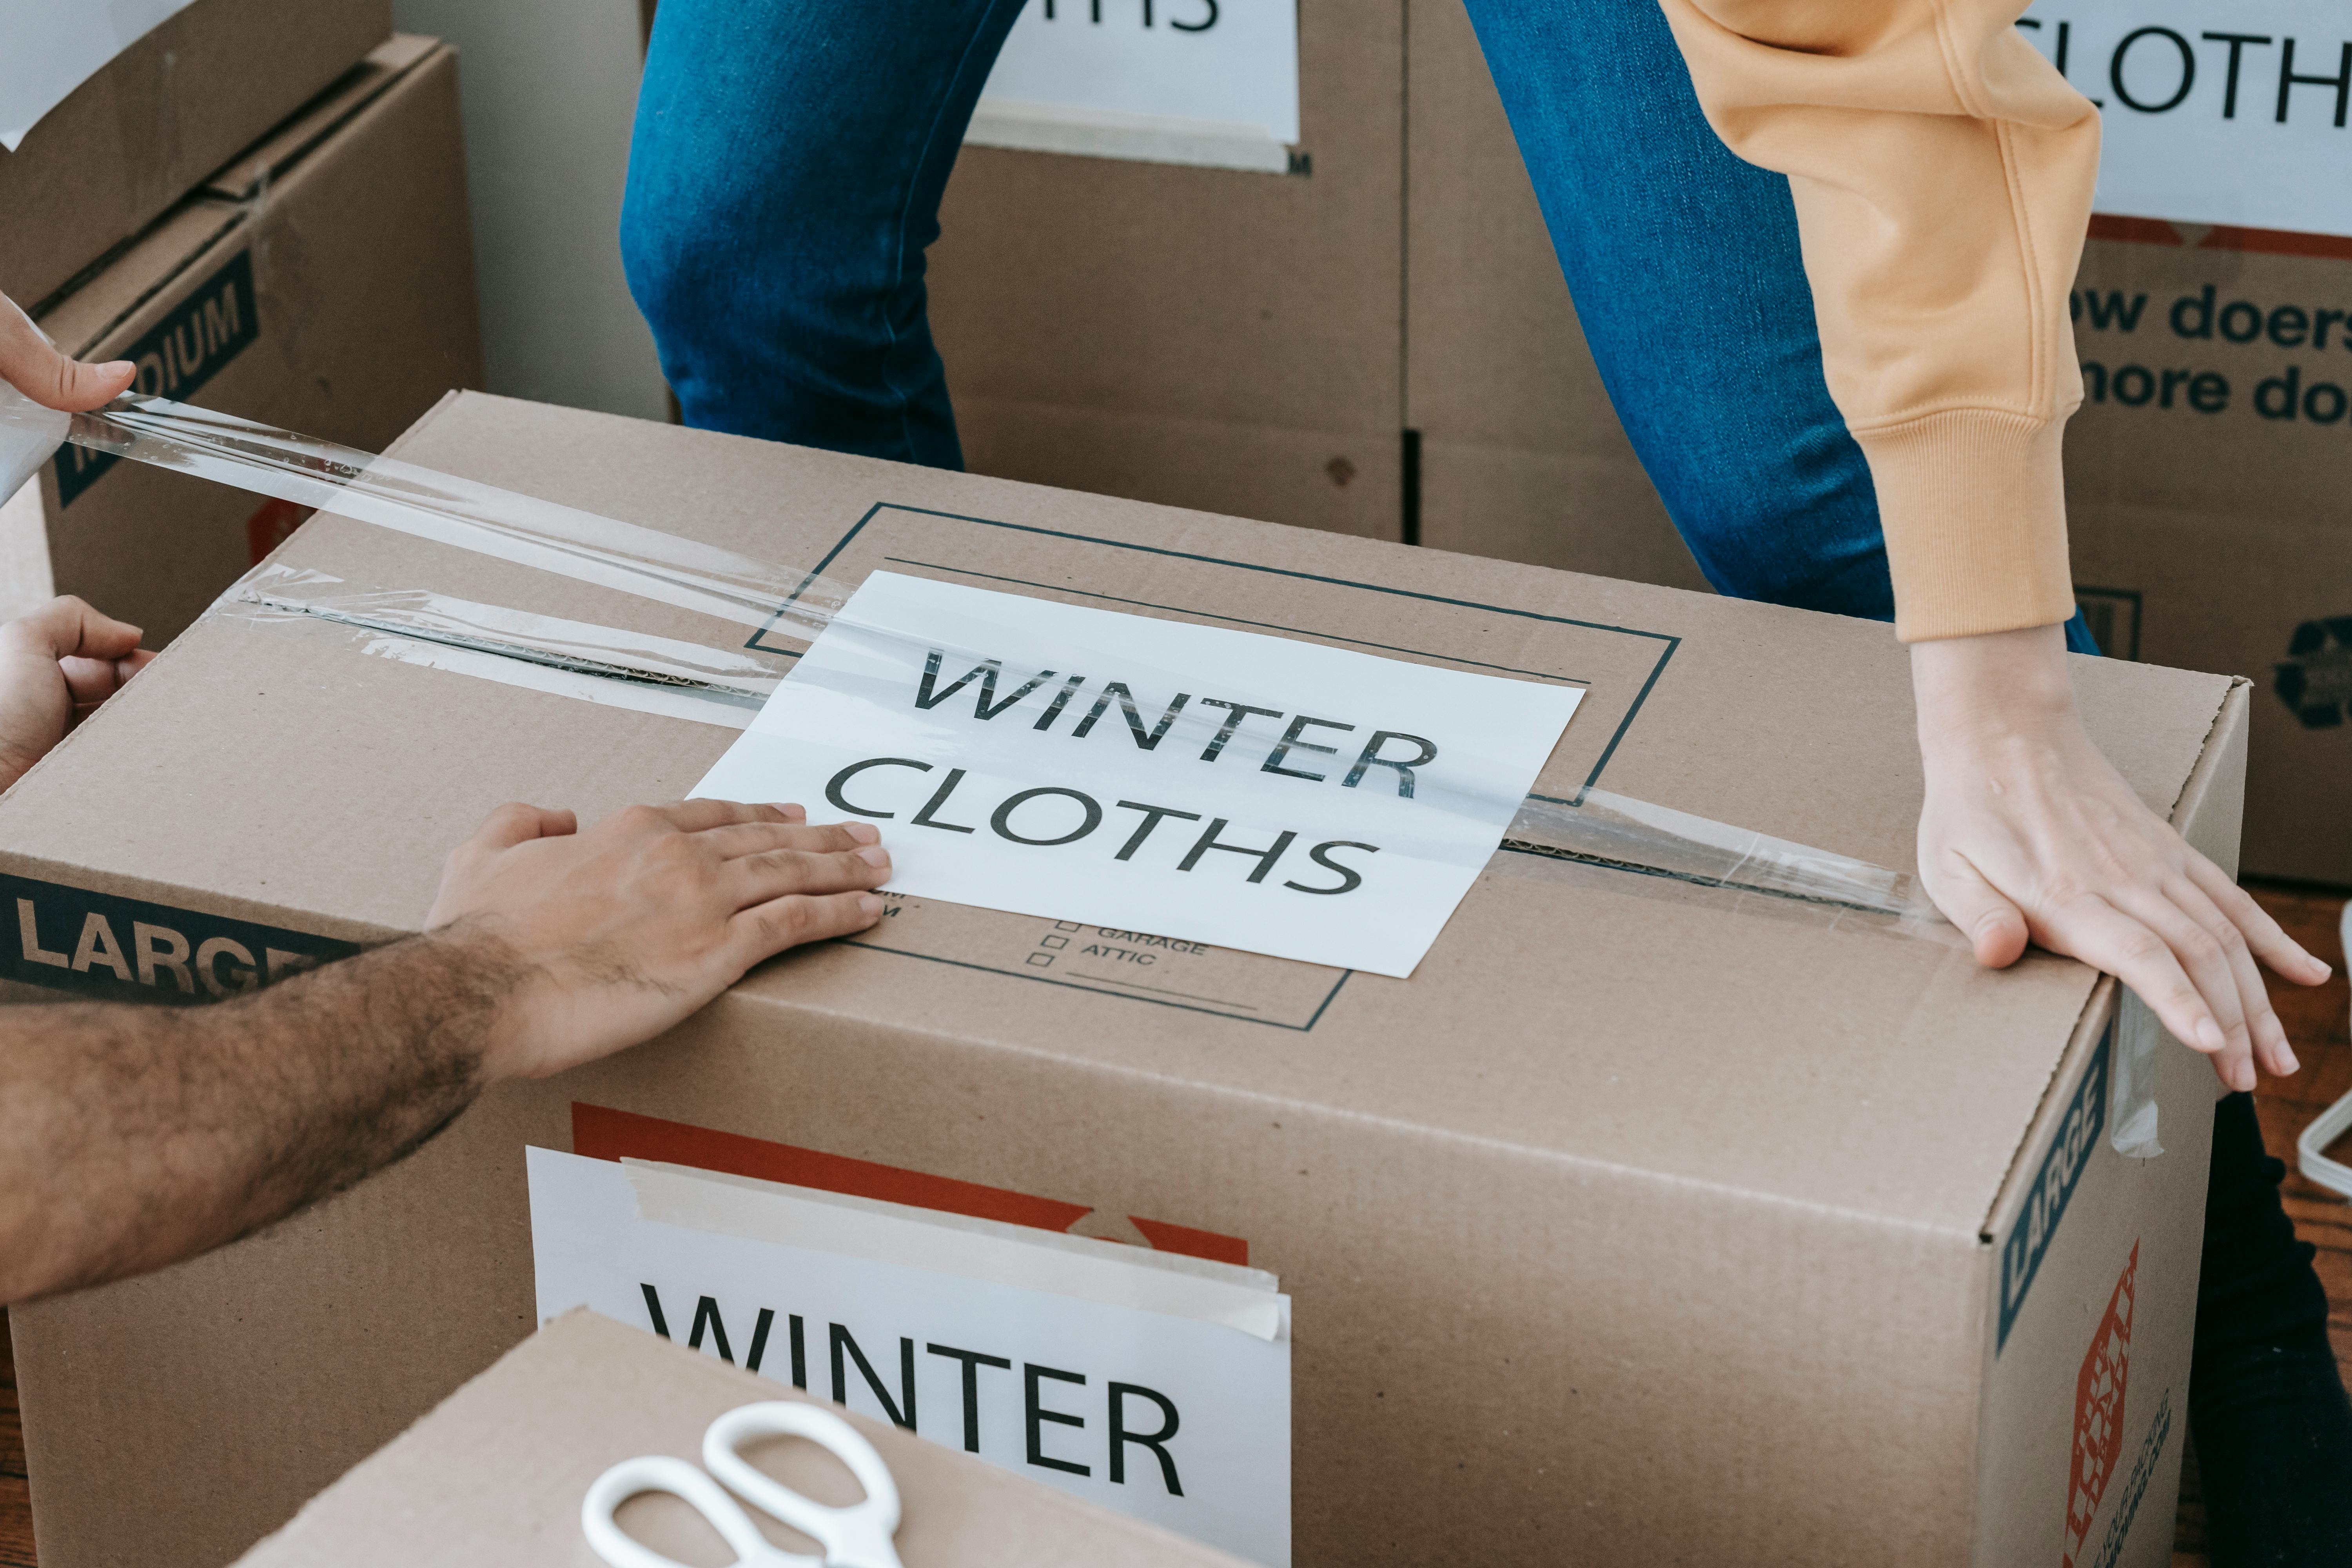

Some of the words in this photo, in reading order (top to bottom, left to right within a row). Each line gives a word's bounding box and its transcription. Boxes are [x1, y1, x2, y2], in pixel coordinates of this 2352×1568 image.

[2014, 18, 2352, 127] LOTH
[2254, 365, 2352, 426] do
[915, 649, 1437, 799] WINTER
[824, 757, 1380, 895] CLOTHS
[1081, 944, 1156, 965] ATTIC
[1098, 927, 1210, 955] GARAGE
[2008, 1064, 2098, 1309] LARGE
[2076, 1342, 2107, 1454] THE
[2087, 1320, 2130, 1515] DEPOT
[2103, 1486, 2129, 1563] YOUR
[2129, 1388, 2169, 1498] PACKING
